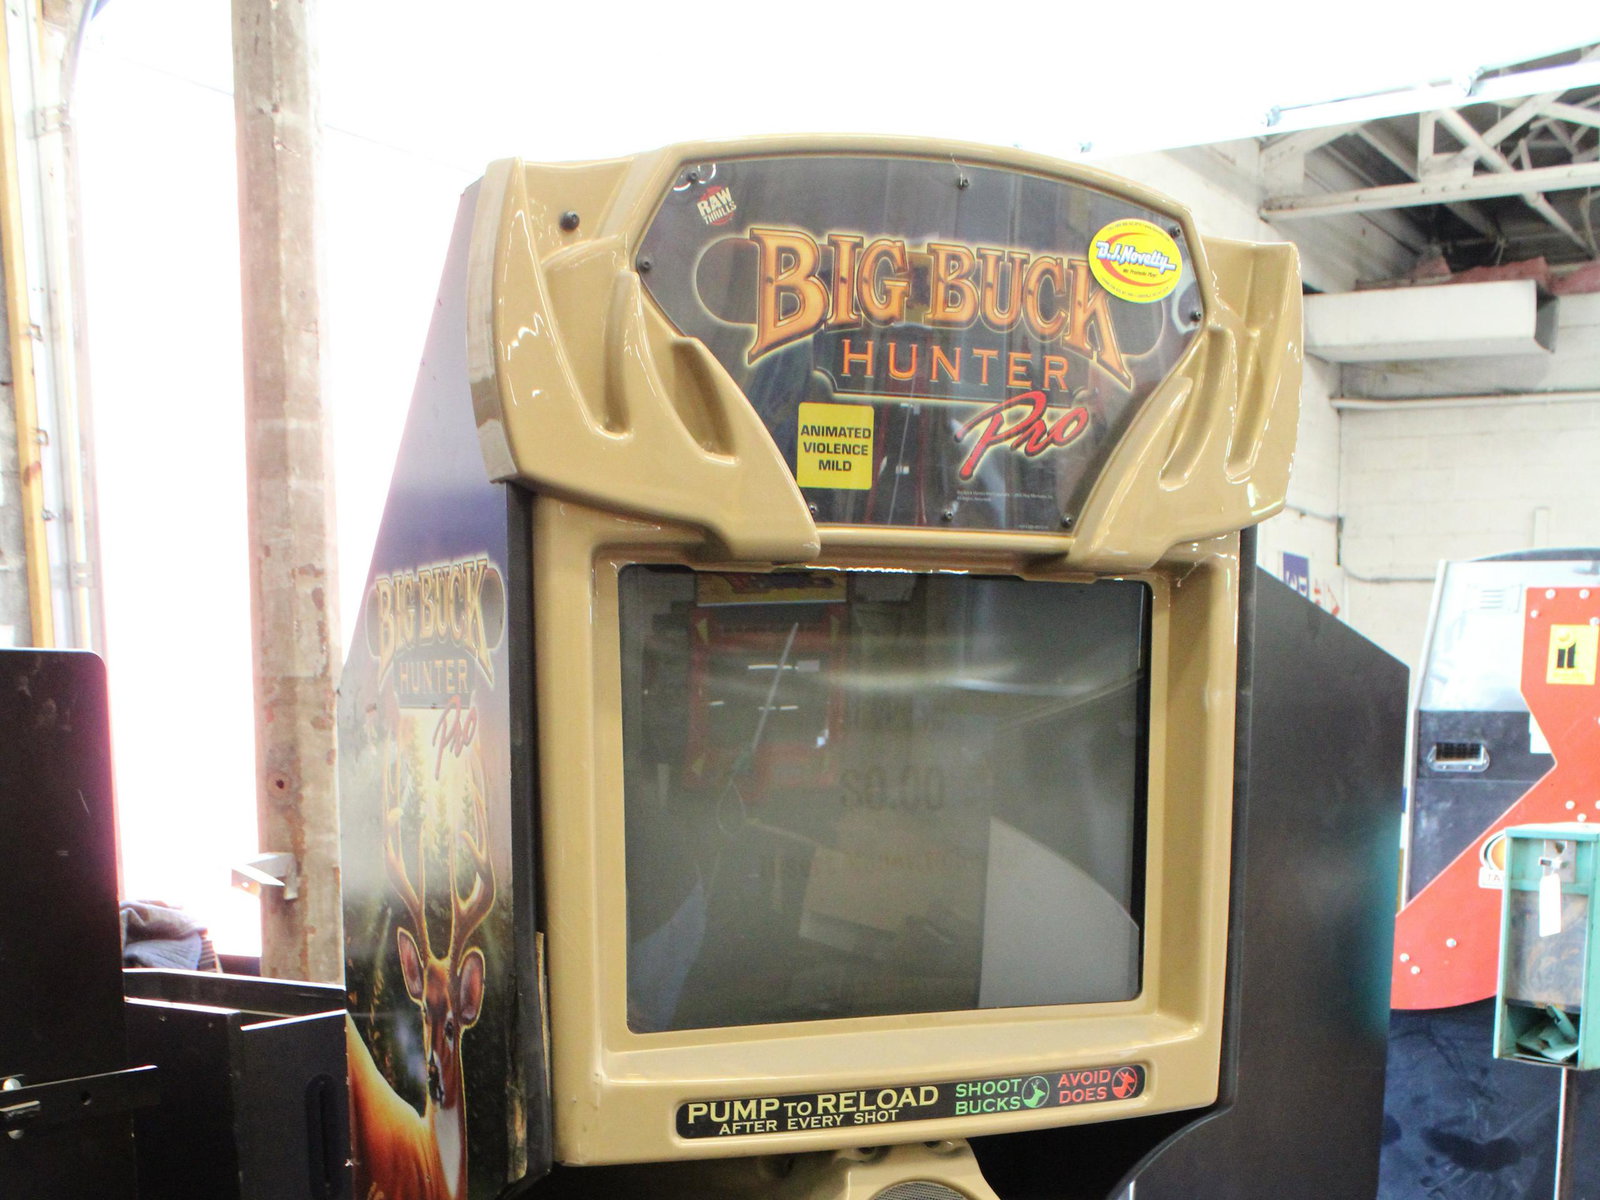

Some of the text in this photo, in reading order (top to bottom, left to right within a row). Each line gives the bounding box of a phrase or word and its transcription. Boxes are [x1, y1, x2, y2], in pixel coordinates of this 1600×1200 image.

[697, 187, 732, 217] RAW
[748, 227, 1134, 391] BIG BUCK
[841, 339, 1070, 392] HUNTER
[801, 424, 871, 439] ANIMATED
[953, 390, 1089, 481] Pro
[803, 441, 869, 456] VIOLENCE
[818, 459, 852, 472] MILD
[376, 558, 494, 689] BIG BUCK
[400, 659, 469, 693] HUNTER
[432, 694, 478, 780] Pro
[955, 1077, 1023, 1098] SHOOT
[1056, 1069, 1112, 1088] AVOID
[687, 1086, 940, 1124] PUMP TO RELOAD
[955, 1096, 1022, 1116] BUCKS
[1058, 1086, 1108, 1105] DOES
[718, 1109, 900, 1135] AFTER EVERY SHOT
